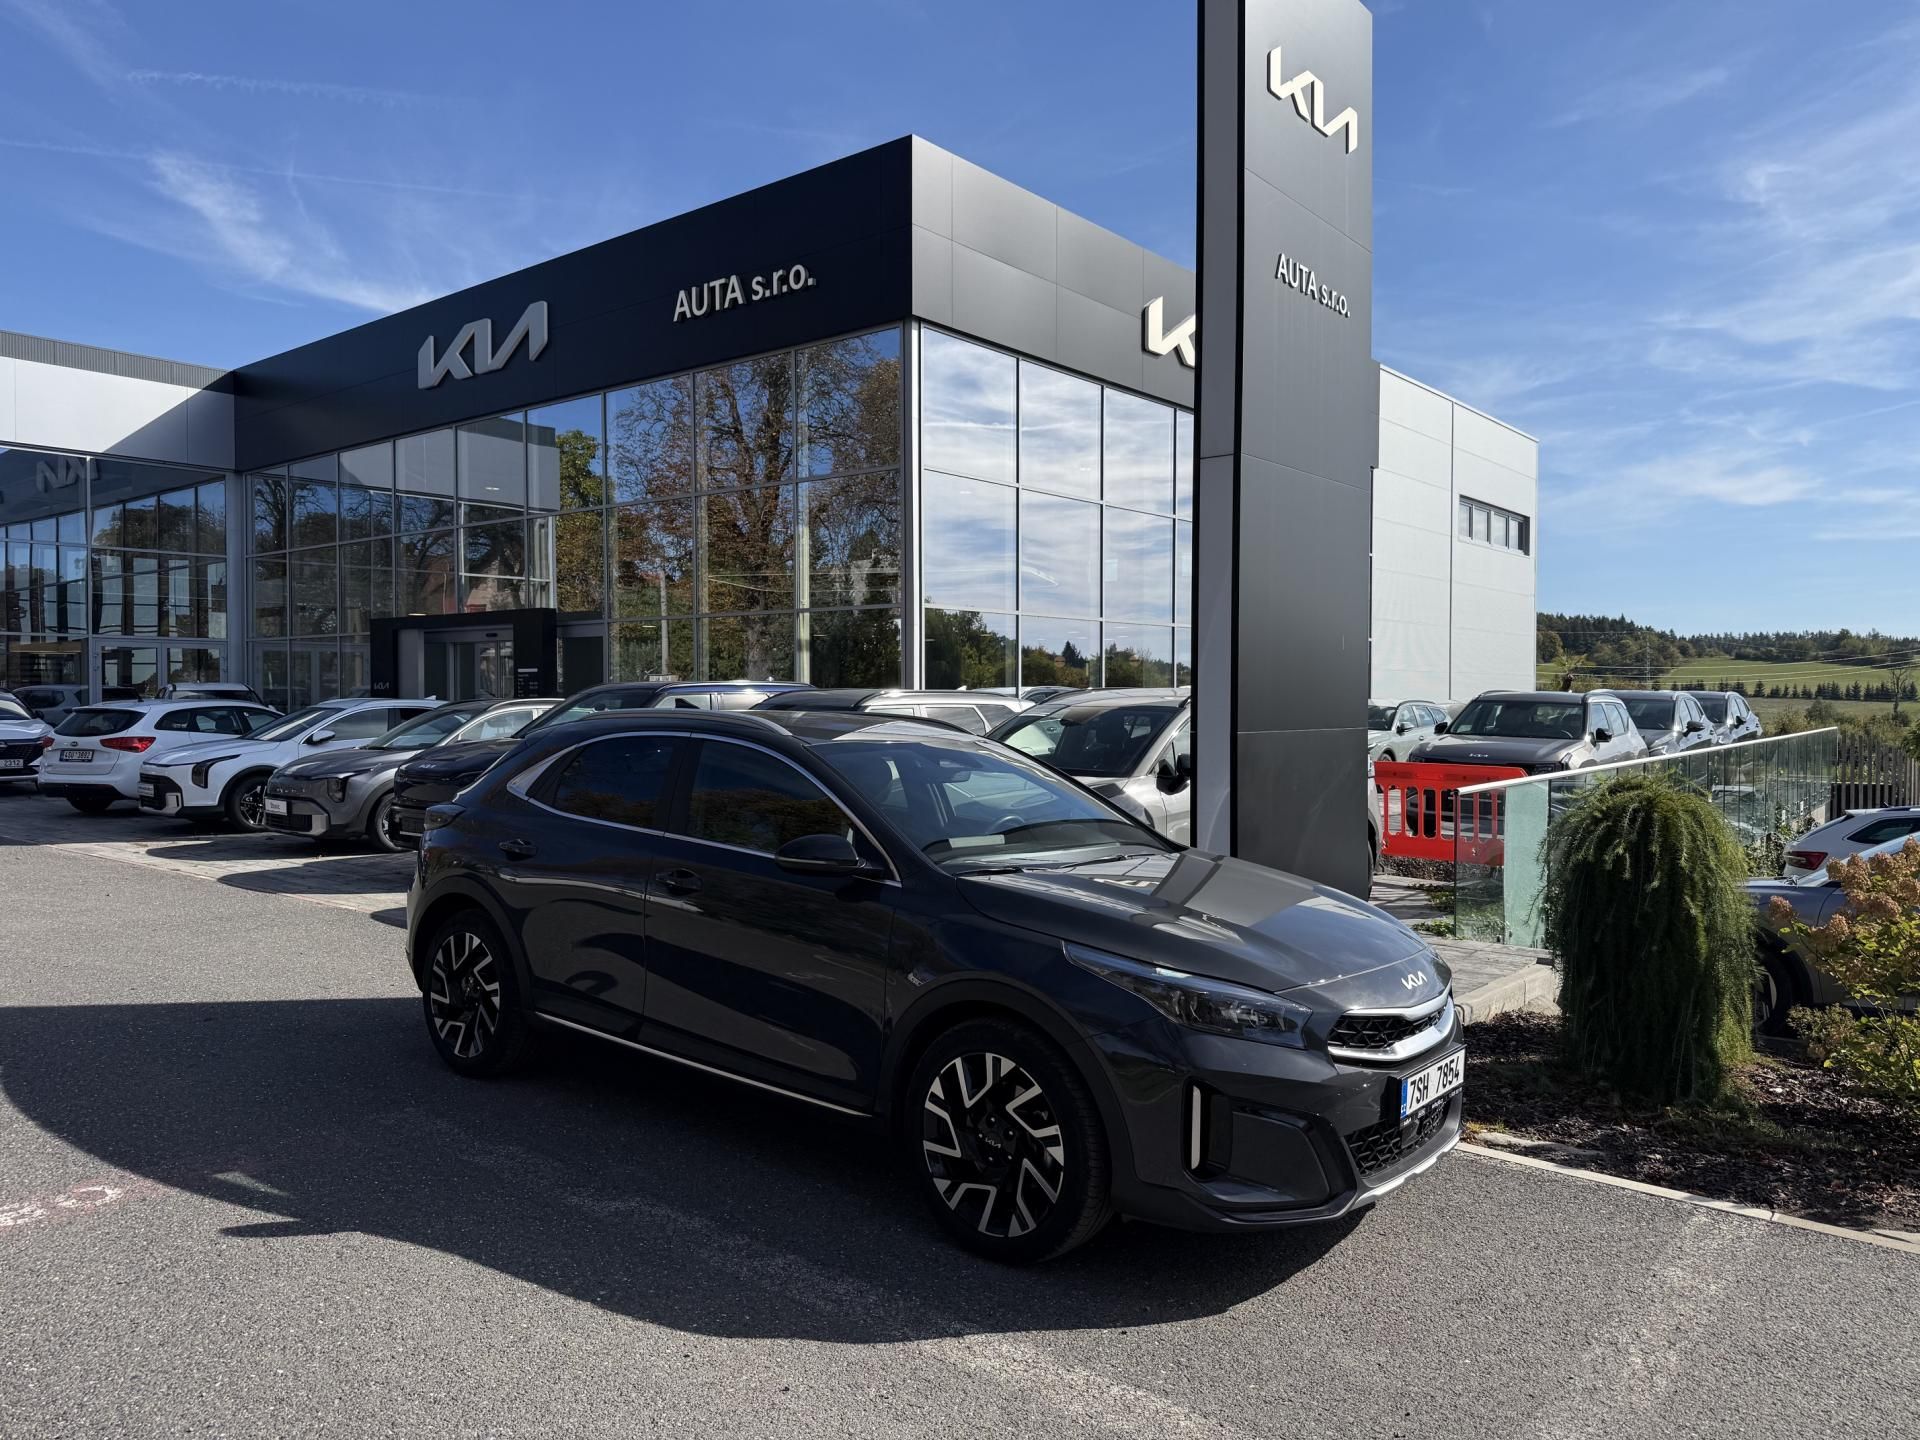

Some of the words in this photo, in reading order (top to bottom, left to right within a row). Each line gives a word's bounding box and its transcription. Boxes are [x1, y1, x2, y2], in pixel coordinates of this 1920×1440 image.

[1267, 46, 1357, 154] KIA
[672, 274, 745, 322] AUTA
[751, 264, 817, 301] s.r.o.
[1275, 253, 1317, 299] AUTA
[1318, 283, 1350, 318] s.r.o.
[418, 301, 548, 389] KIA
[1401, 971, 1428, 990] KIA
[1409, 1072, 1429, 1109] 7SH
[1436, 1056, 1459, 1094] 7854
[985, 1138, 1001, 1148] KIA
